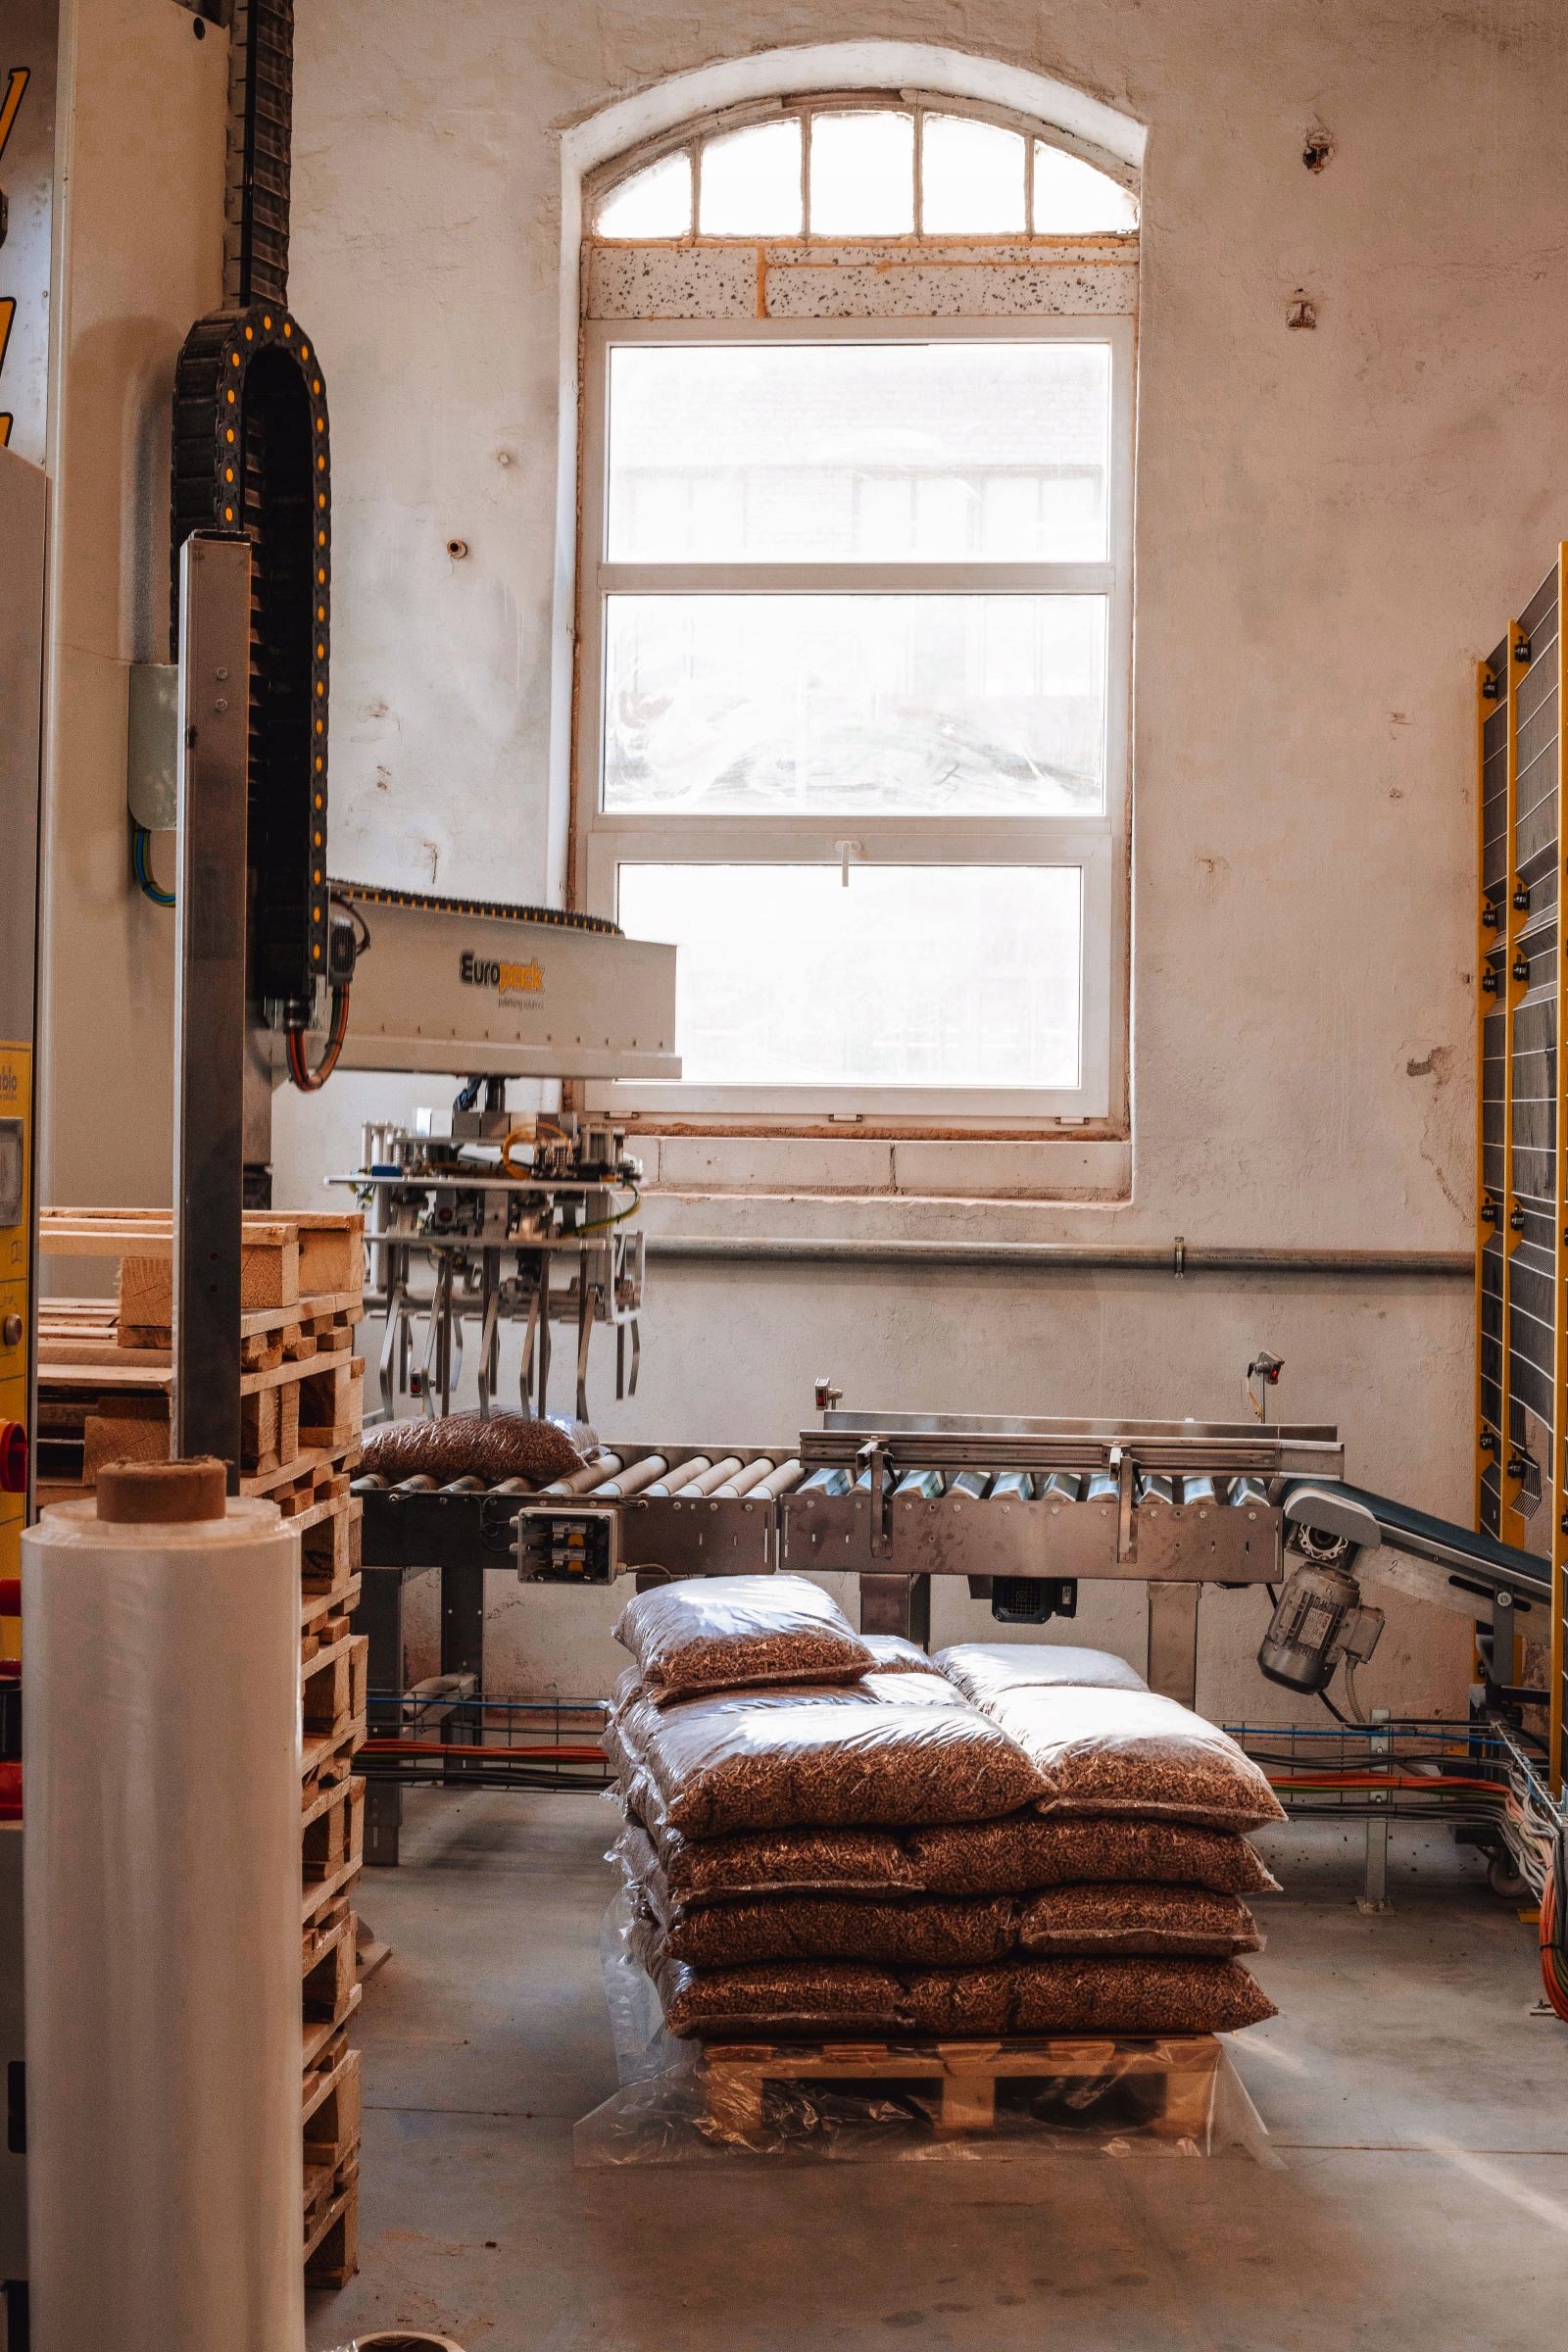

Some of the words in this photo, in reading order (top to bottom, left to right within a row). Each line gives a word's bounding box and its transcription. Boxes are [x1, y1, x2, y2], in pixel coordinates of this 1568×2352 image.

[461, 951, 546, 995] Europack
[0, 1066, 18, 1092] blo
[1388, 1559, 1398, 1574] 2
